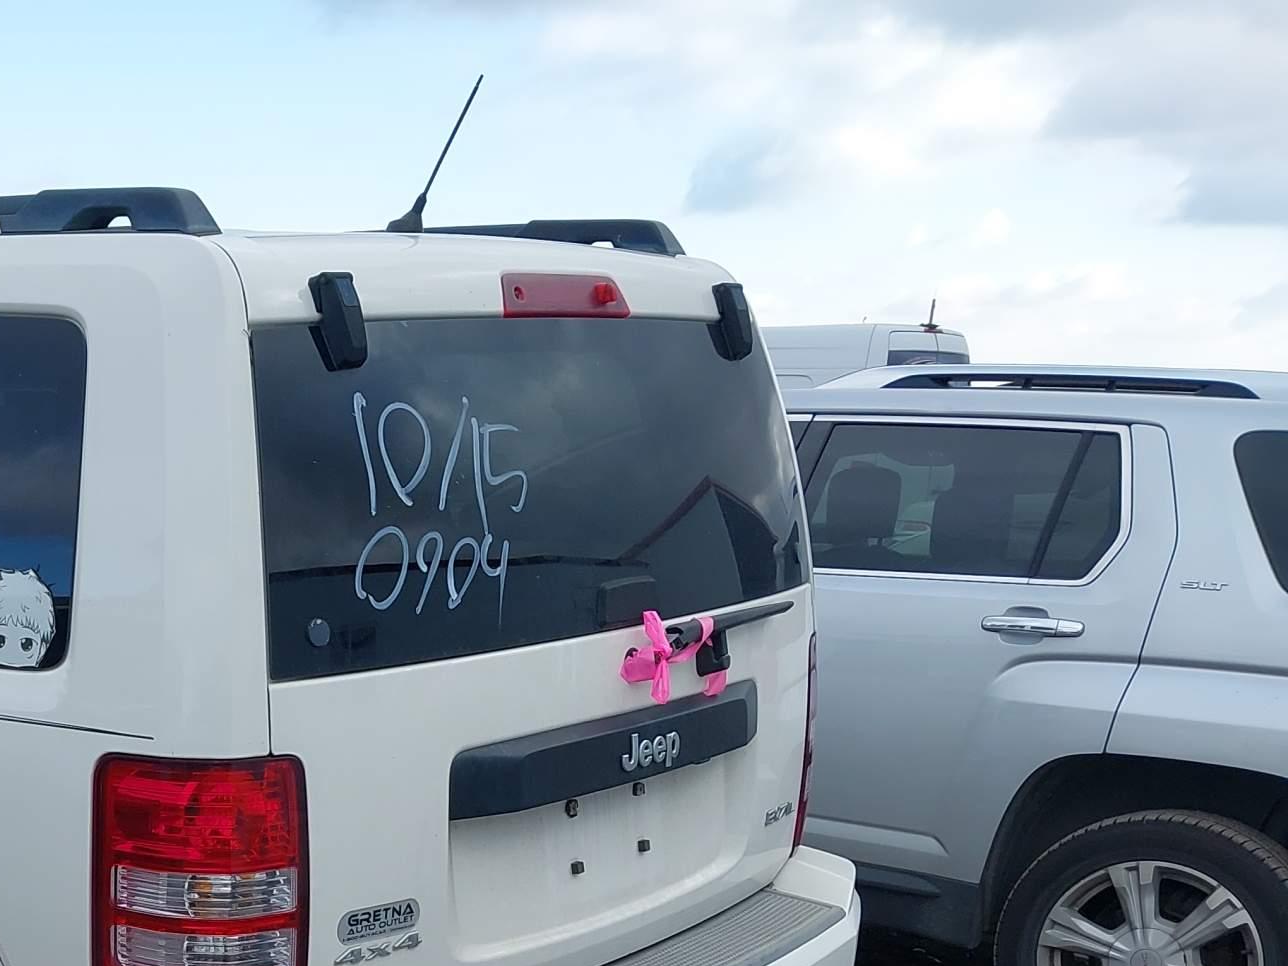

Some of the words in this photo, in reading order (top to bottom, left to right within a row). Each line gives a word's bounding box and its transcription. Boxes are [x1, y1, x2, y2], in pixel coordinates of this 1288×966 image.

[353, 392, 528, 534] 10/15
[355, 526, 510, 624] 0904
[1179, 580, 1230, 592] SLT
[622, 731, 680, 771] Jeep
[346, 923, 376, 936] AUTO
[379, 914, 415, 929] OUTLET
[347, 903, 415, 927] GRETNA
